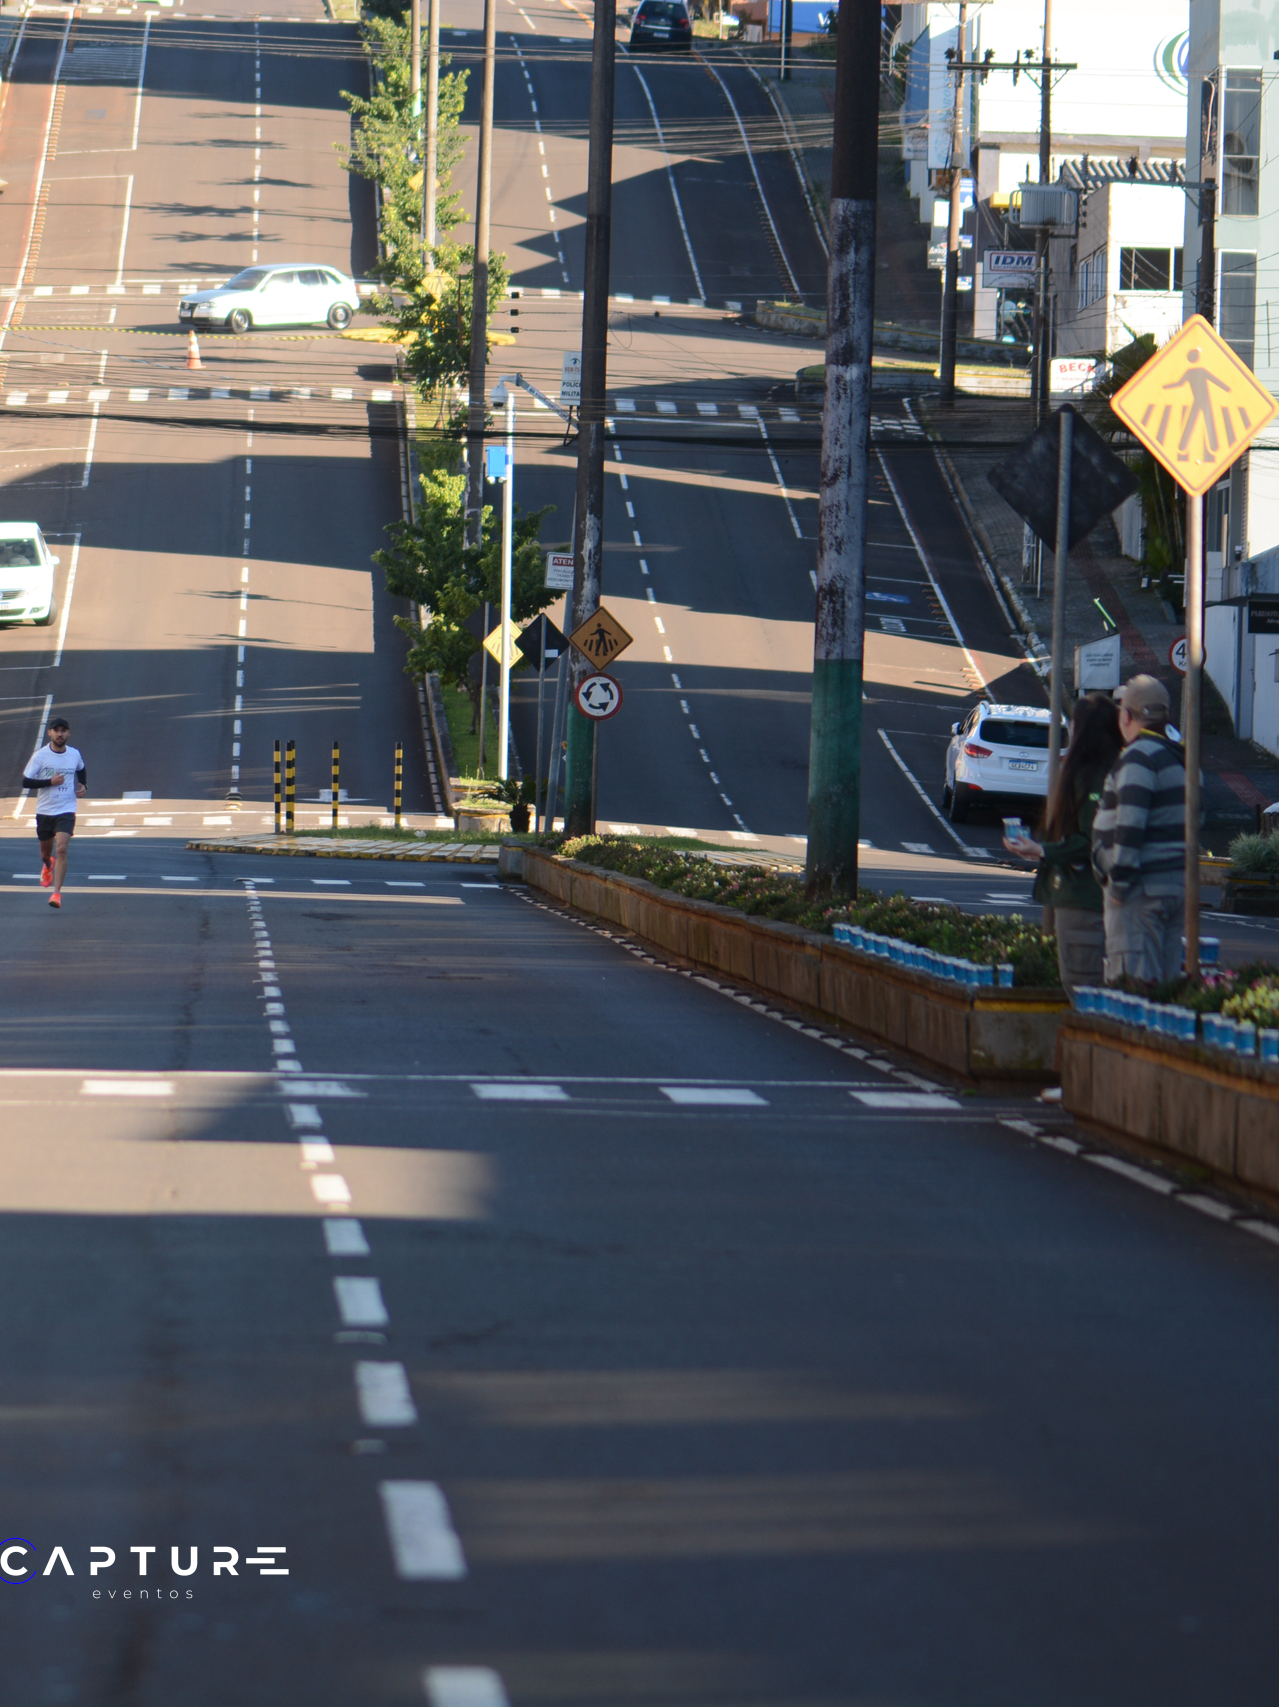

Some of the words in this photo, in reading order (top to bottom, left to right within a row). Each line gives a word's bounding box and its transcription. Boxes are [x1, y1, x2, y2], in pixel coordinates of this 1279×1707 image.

[994, 255, 1033, 265] IDM
[553, 558, 574, 566] ATEN
[1175, 642, 1187, 659] 4
